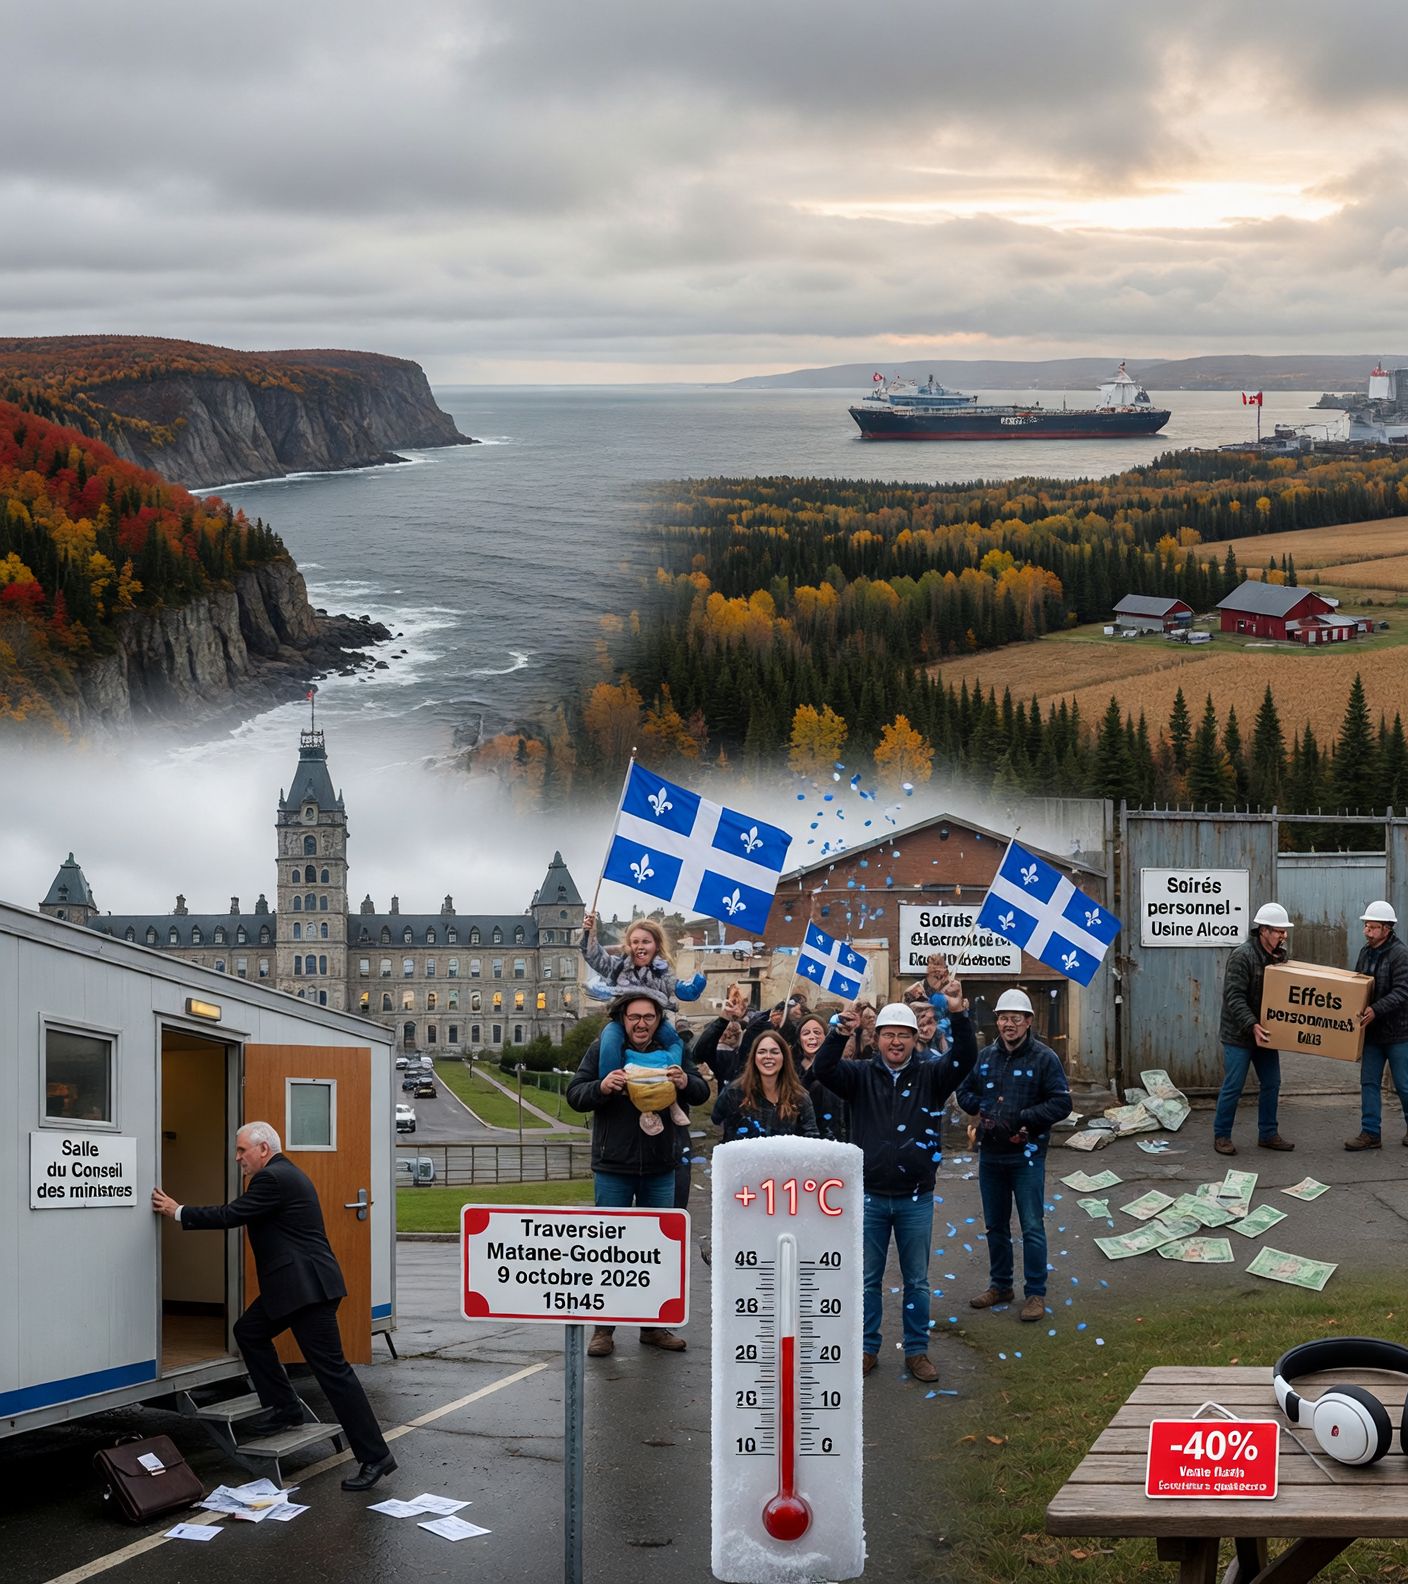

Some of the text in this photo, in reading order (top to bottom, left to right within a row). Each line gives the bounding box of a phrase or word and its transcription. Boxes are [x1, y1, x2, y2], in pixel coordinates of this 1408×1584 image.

[1167, 876, 1222, 893] Soirés
[1148, 900, 1229, 917] personnel
[1152, 921, 1239, 936] Usine Alcoa
[1288, 985, 1342, 1010] Effets
[62, 1139, 99, 1156] Salle
[47, 1161, 122, 1178] du Conseil
[37, 1182, 65, 1198] des
[735, 1178, 844, 1216] +11°C
[521, 1218, 626, 1239] Traversier
[487, 1242, 661, 1265] Matane-Godbout
[819, 1252, 841, 1267] 40
[497, 1266, 650, 1287] 9 octobre 2026
[543, 1292, 605, 1310] 15h45
[821, 1391, 841, 1407] 10
[1170, 1430, 1258, 1461] -40%
